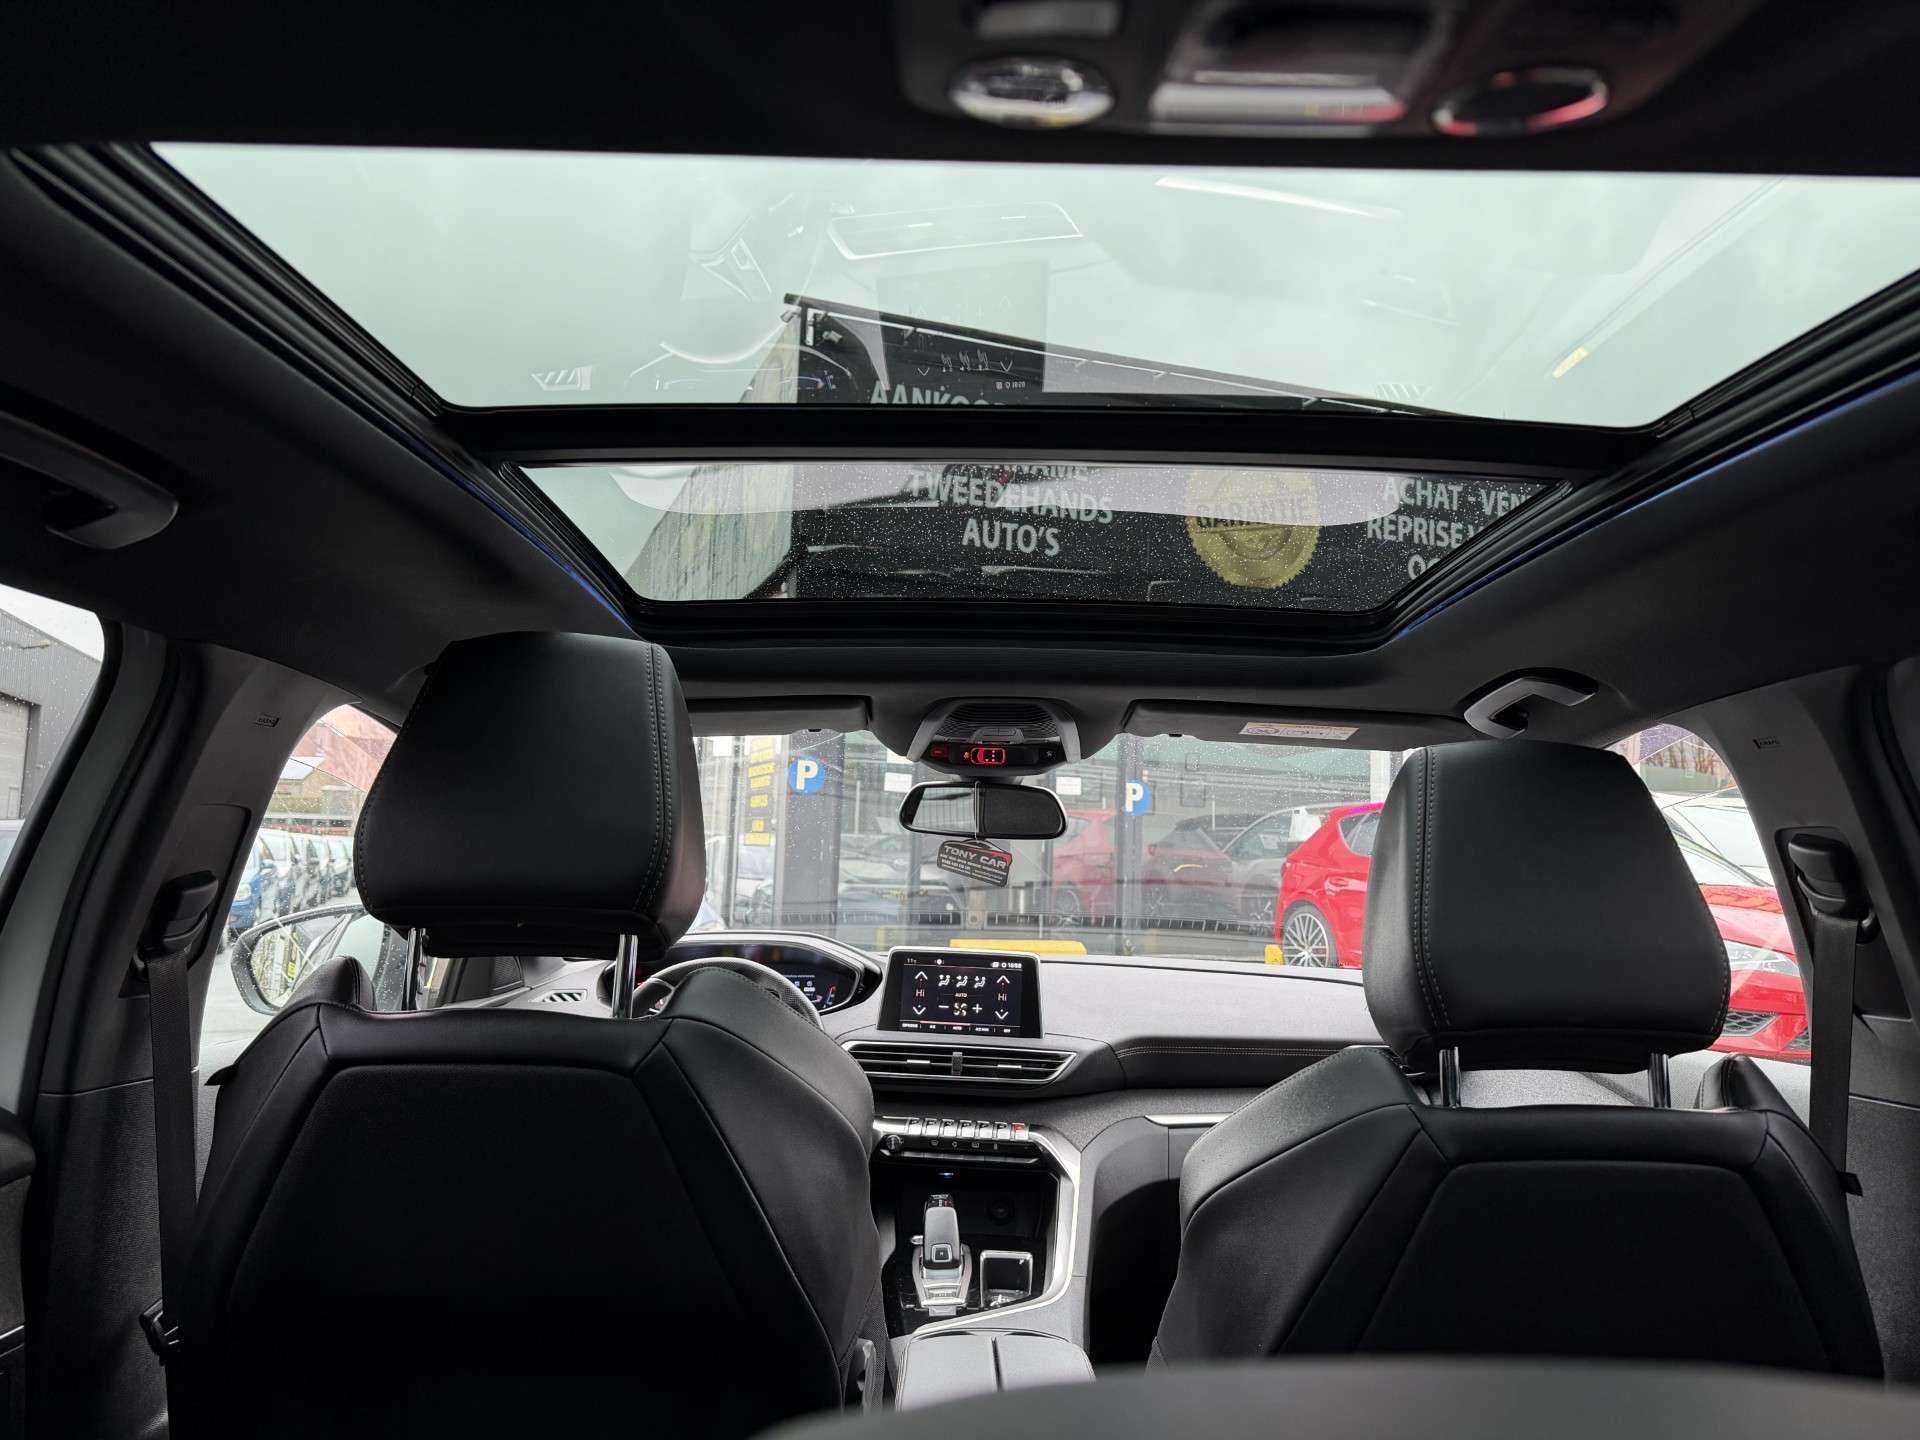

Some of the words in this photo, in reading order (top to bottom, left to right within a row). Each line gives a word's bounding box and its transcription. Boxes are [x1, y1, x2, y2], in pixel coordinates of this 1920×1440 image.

[1383, 477, 1464, 511] ACHAT
[961, 518, 1061, 557] AUTO'S
[796, 759, 819, 791] P
[1125, 782, 1144, 812] P
[944, 845, 977, 860] TONY
[980, 856, 1007, 869] CAR
